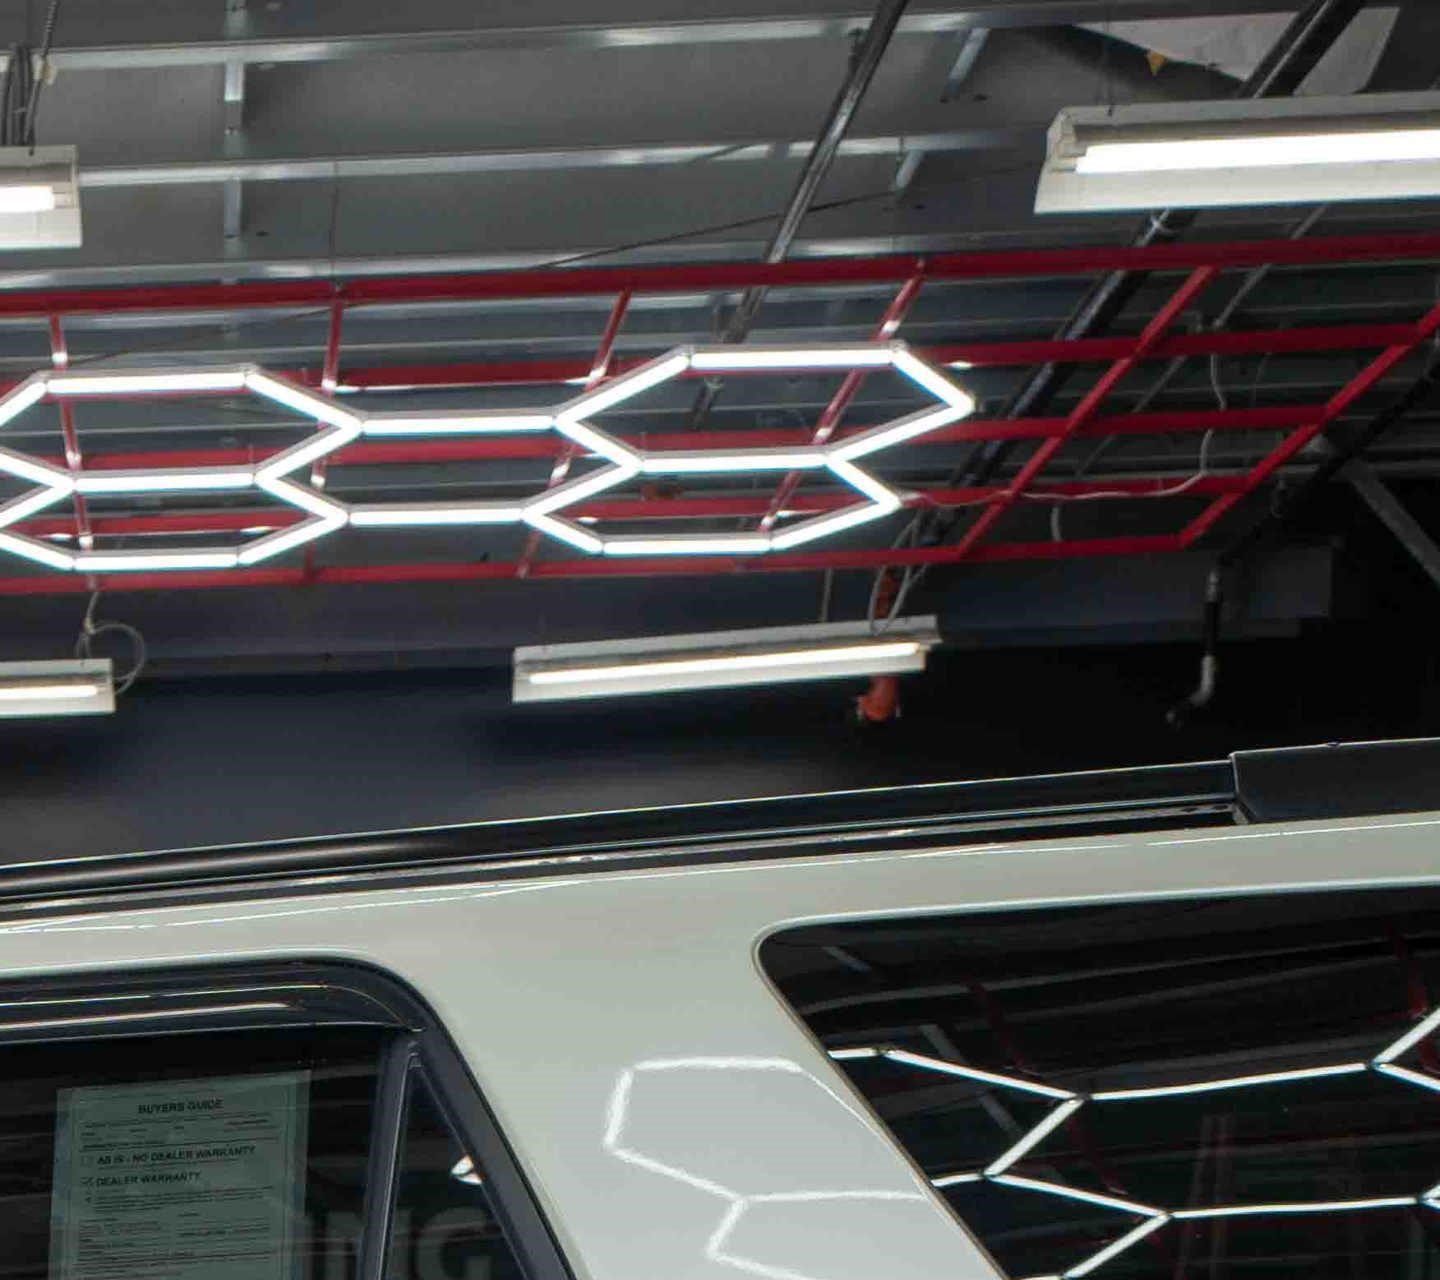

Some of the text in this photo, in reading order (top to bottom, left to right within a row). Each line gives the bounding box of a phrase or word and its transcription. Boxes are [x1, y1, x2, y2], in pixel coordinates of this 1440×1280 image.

[138, 1100, 224, 1114] BUYERS GUIDE
[151, 1150, 193, 1162] DEALER
[195, 1145, 256, 1159] WARRANTY
[96, 1171, 202, 1187] DEALER WARRANTY
